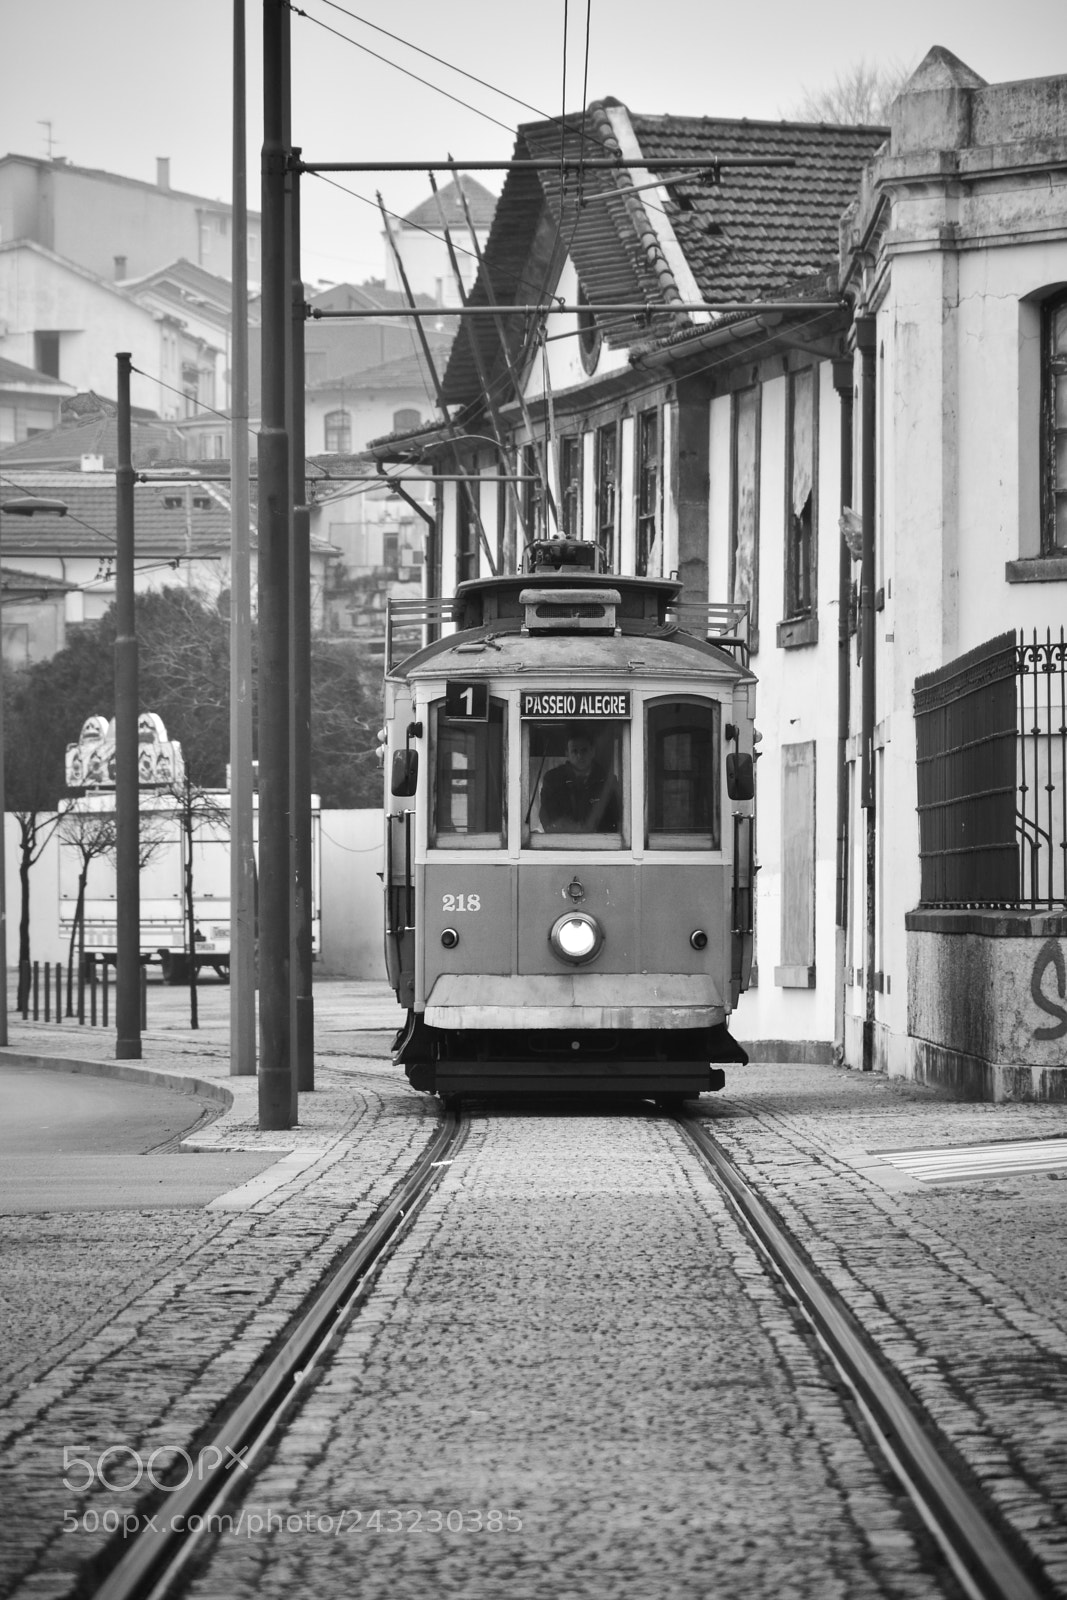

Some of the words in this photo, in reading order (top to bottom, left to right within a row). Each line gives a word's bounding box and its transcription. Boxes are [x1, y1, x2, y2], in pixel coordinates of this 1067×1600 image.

[459, 686, 474, 716] 1
[525, 695, 576, 714] PASSEIO
[579, 695, 626, 714] ALEGRE
[441, 893, 482, 912] 218
